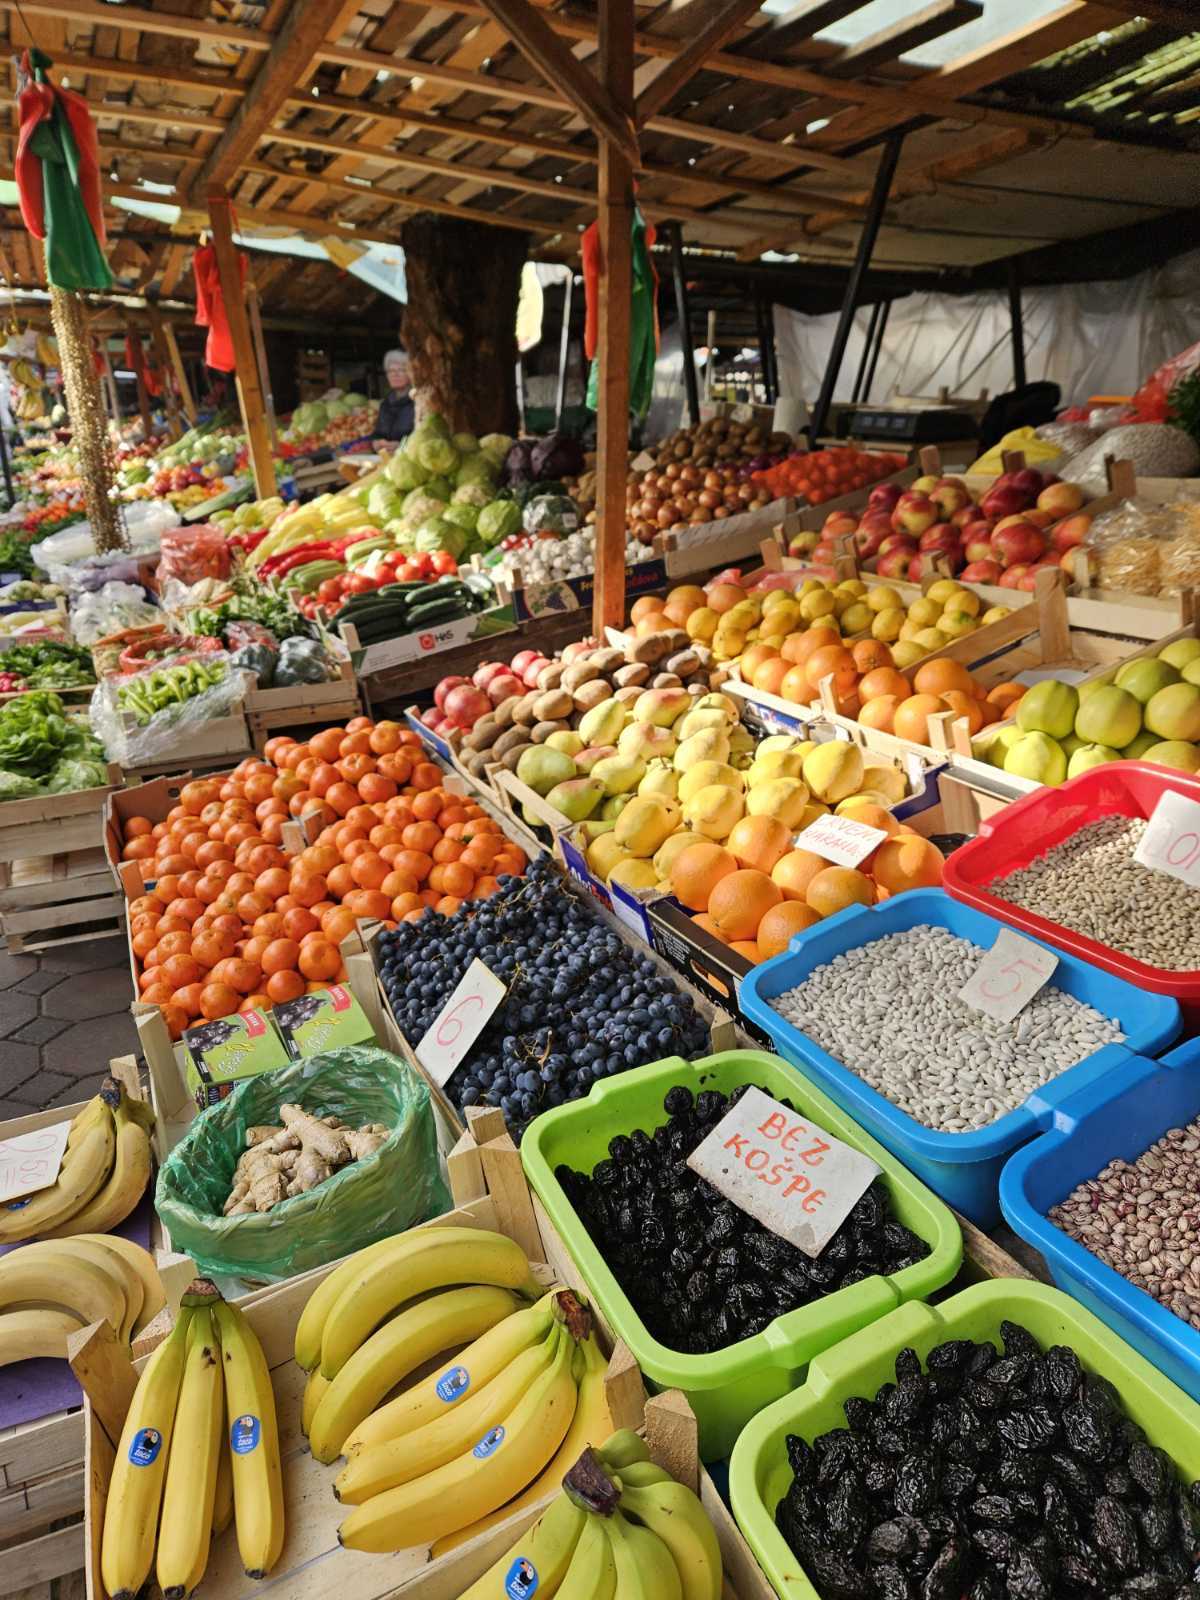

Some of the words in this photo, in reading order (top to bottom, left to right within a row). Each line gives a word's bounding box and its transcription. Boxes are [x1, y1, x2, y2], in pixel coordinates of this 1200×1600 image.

[979, 958, 1047, 1001] 5
[757, 1111, 832, 1167] BEZ
[723, 1133, 827, 1215] KOŠPE
[510, 1581, 527, 1597] toco
